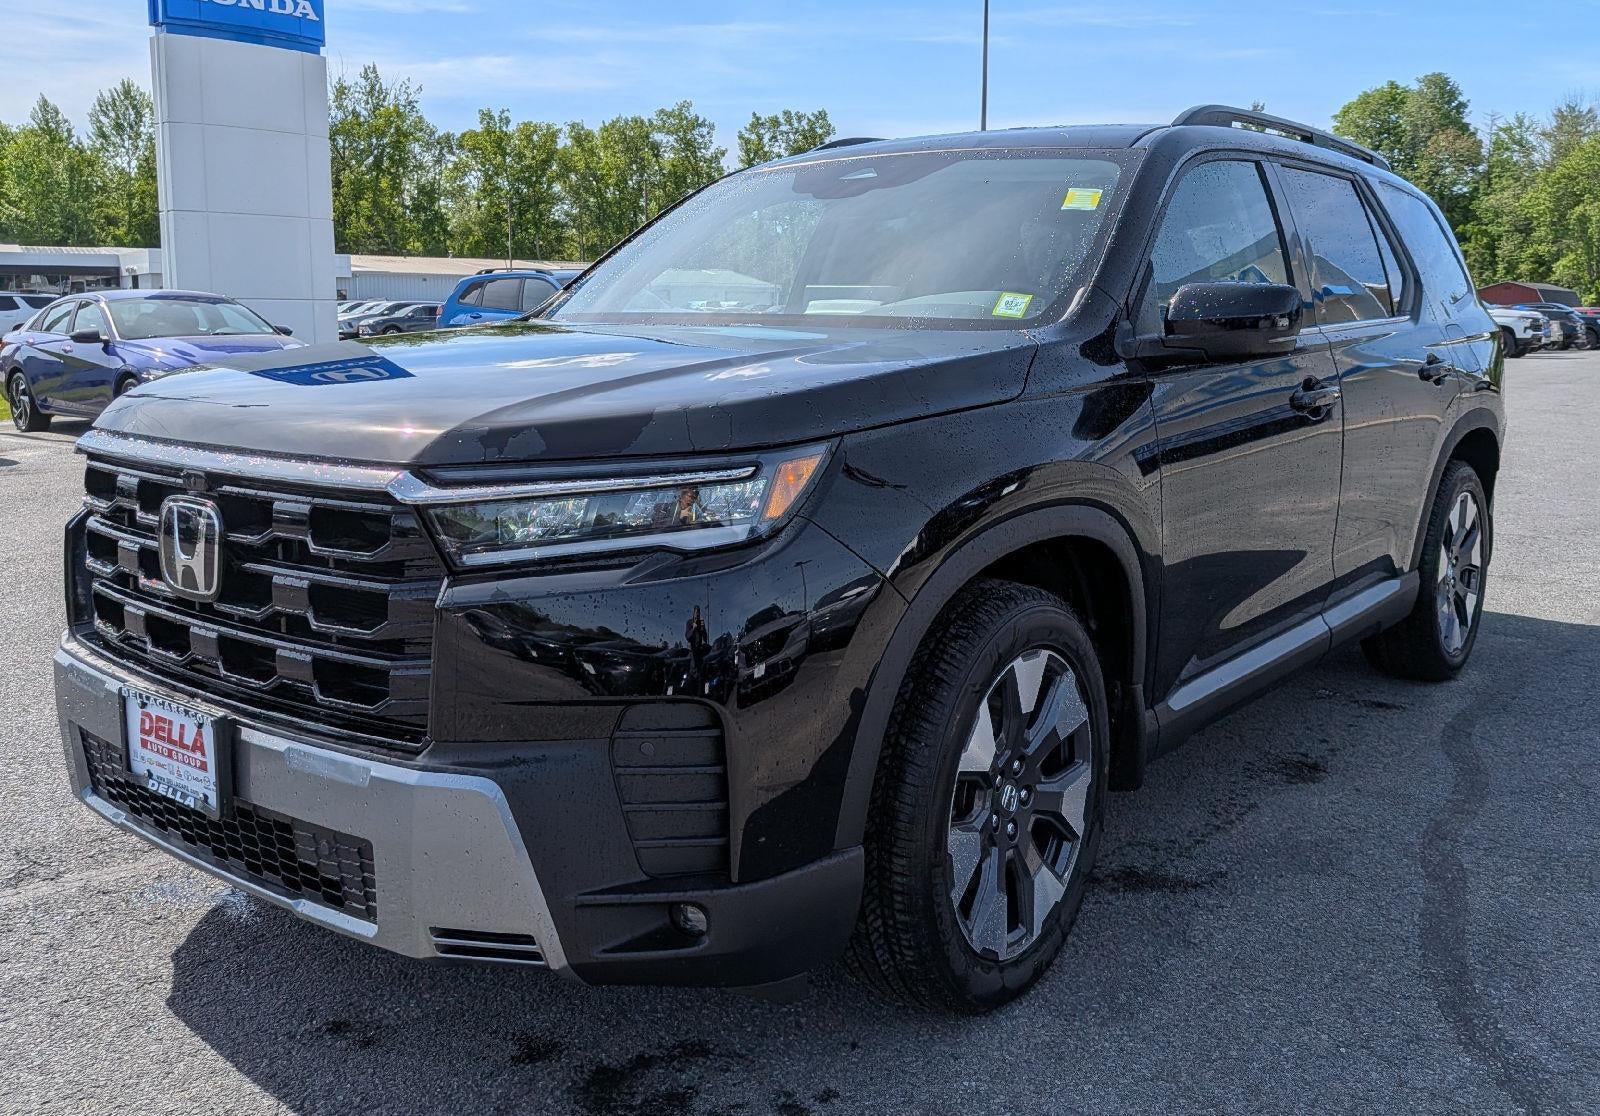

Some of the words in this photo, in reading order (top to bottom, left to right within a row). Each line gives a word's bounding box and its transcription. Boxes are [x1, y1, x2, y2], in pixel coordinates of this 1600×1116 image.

[140, 709, 207, 758] DELLA
[147, 741, 168, 755] AUTO
[172, 750, 201, 768] GROUP
[148, 779, 195, 808] DELLA
